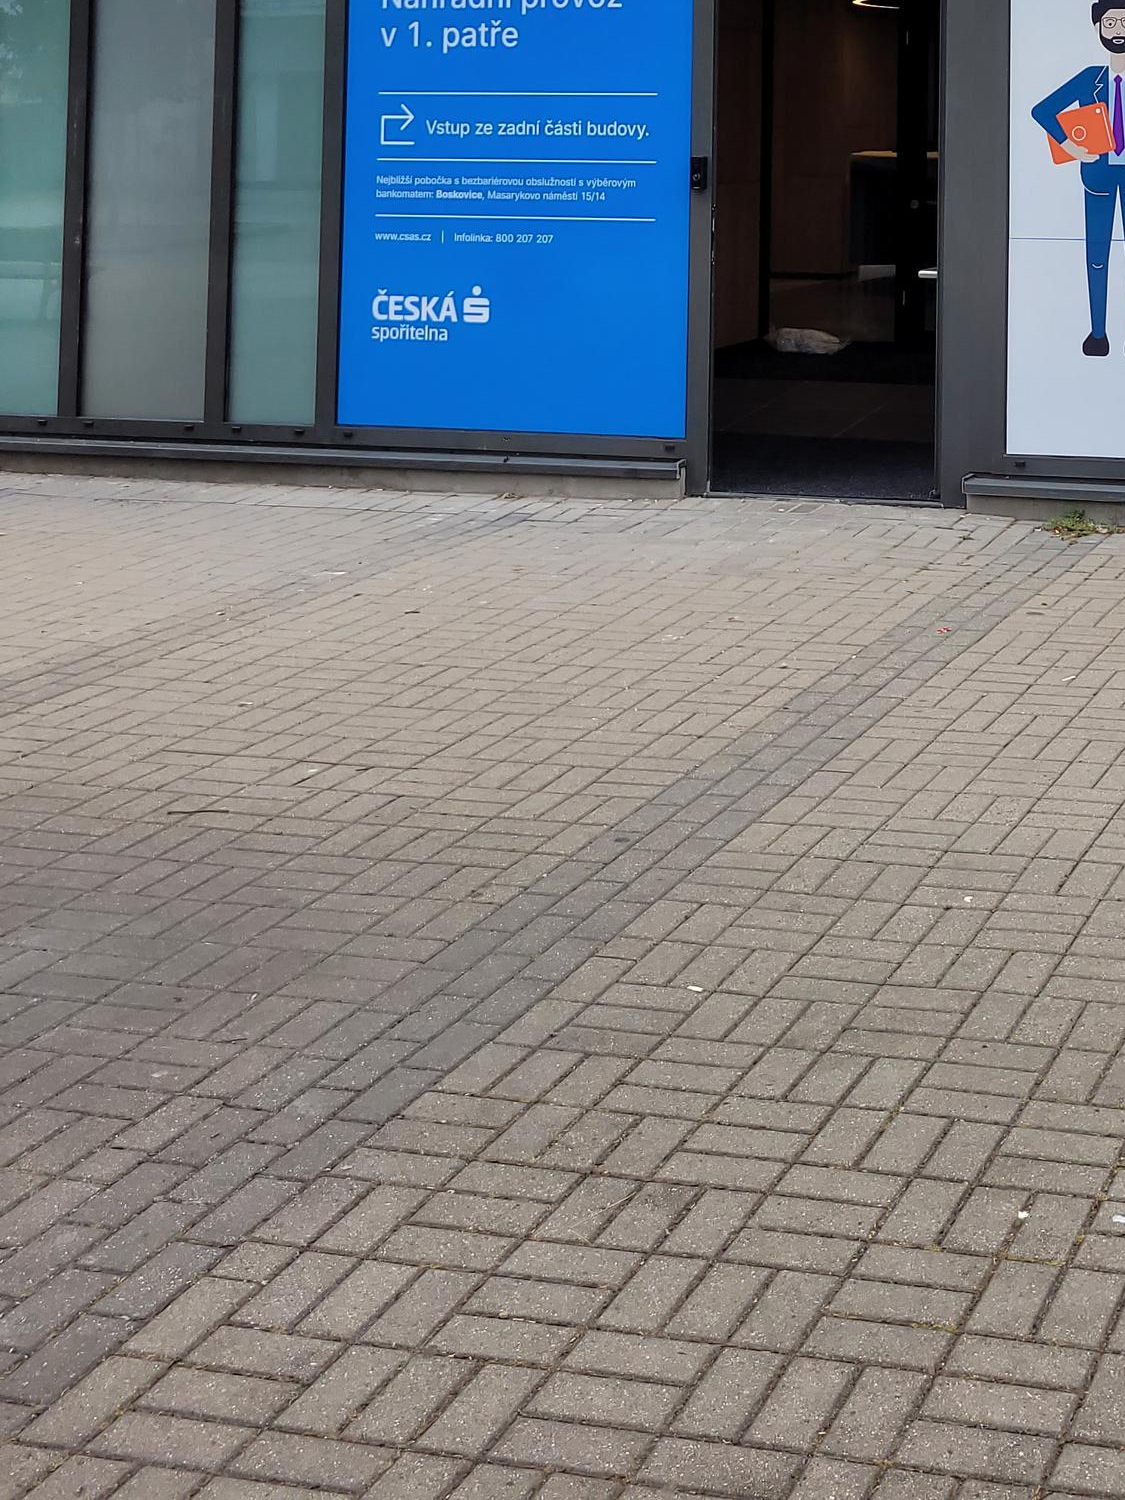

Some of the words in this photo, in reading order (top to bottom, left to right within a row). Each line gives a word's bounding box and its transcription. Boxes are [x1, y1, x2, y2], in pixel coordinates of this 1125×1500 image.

[381, 26, 397, 47] v
[408, 21, 433, 47] 1.
[442, 19, 520, 54] patře
[426, 119, 470, 139] Vstup
[475, 123, 493, 135] ze
[498, 119, 540, 136] zadní
[544, 119, 582, 137] části
[586, 121, 651, 139] budovy.
[376, 175, 412, 186] Nejbližší
[414, 176, 452, 187] pobočka
[461, 176, 523, 187] bezbariérovou
[525, 177, 577, 188] obslužností
[586, 178, 637, 190] výběrovým
[375, 189, 434, 198] bankomatem:
[435, 190, 485, 201] Boskovice,
[487, 190, 541, 202] Masarykovo
[543, 191, 579, 202] náměstí
[581, 191, 606, 202] 15/14
[374, 232, 432, 242] www.csas.cz
[454, 232, 494, 243] Infolinka:
[495, 233, 514, 244] 800
[516, 234, 534, 244] 207
[536, 234, 554, 244] 207
[371, 288, 458, 323] ČESKÁ
[371, 324, 449, 342] spořitelna
